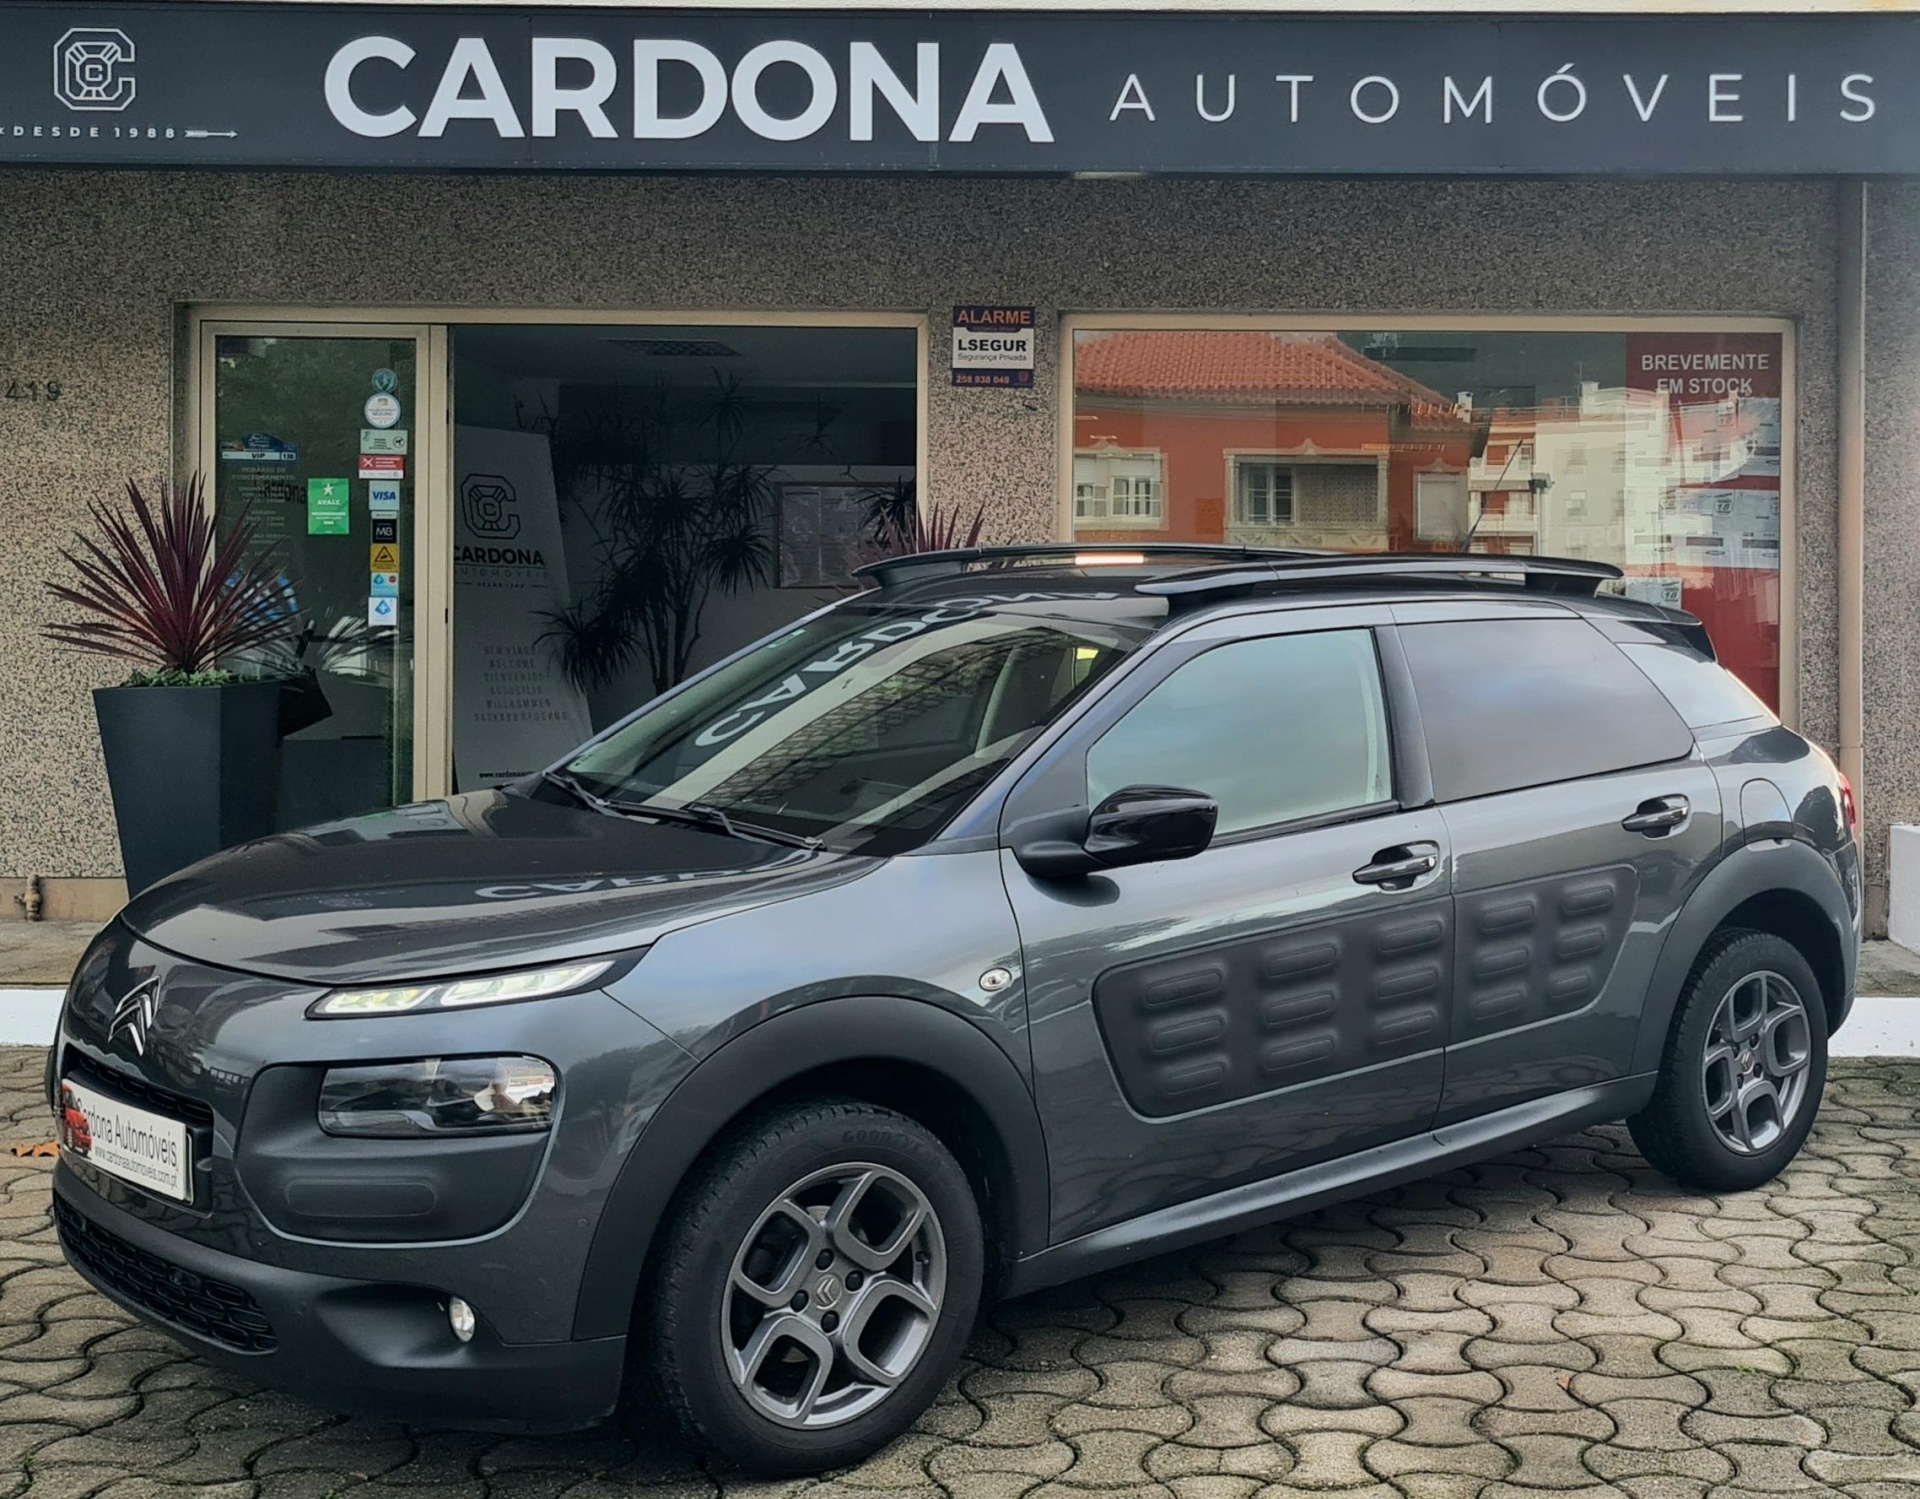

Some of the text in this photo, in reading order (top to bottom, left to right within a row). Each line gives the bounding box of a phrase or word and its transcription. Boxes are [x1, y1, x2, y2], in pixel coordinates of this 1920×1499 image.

[324, 36, 1876, 142] CARDONA AUTOMÓVEIS
[13, 126, 176, 139] DESDE 1988
[957, 309, 1031, 325] ALARME
[957, 339, 1027, 352] LSEGUR
[957, 353, 1027, 363] Segurança Privada
[1641, 353, 1770, 372] BREVEMENTE
[1656, 377, 1754, 396] EM STOCK
[372, 490, 396, 501] VISA
[375, 526, 394, 537] MB
[114, 1113, 178, 1168] Automóveis
